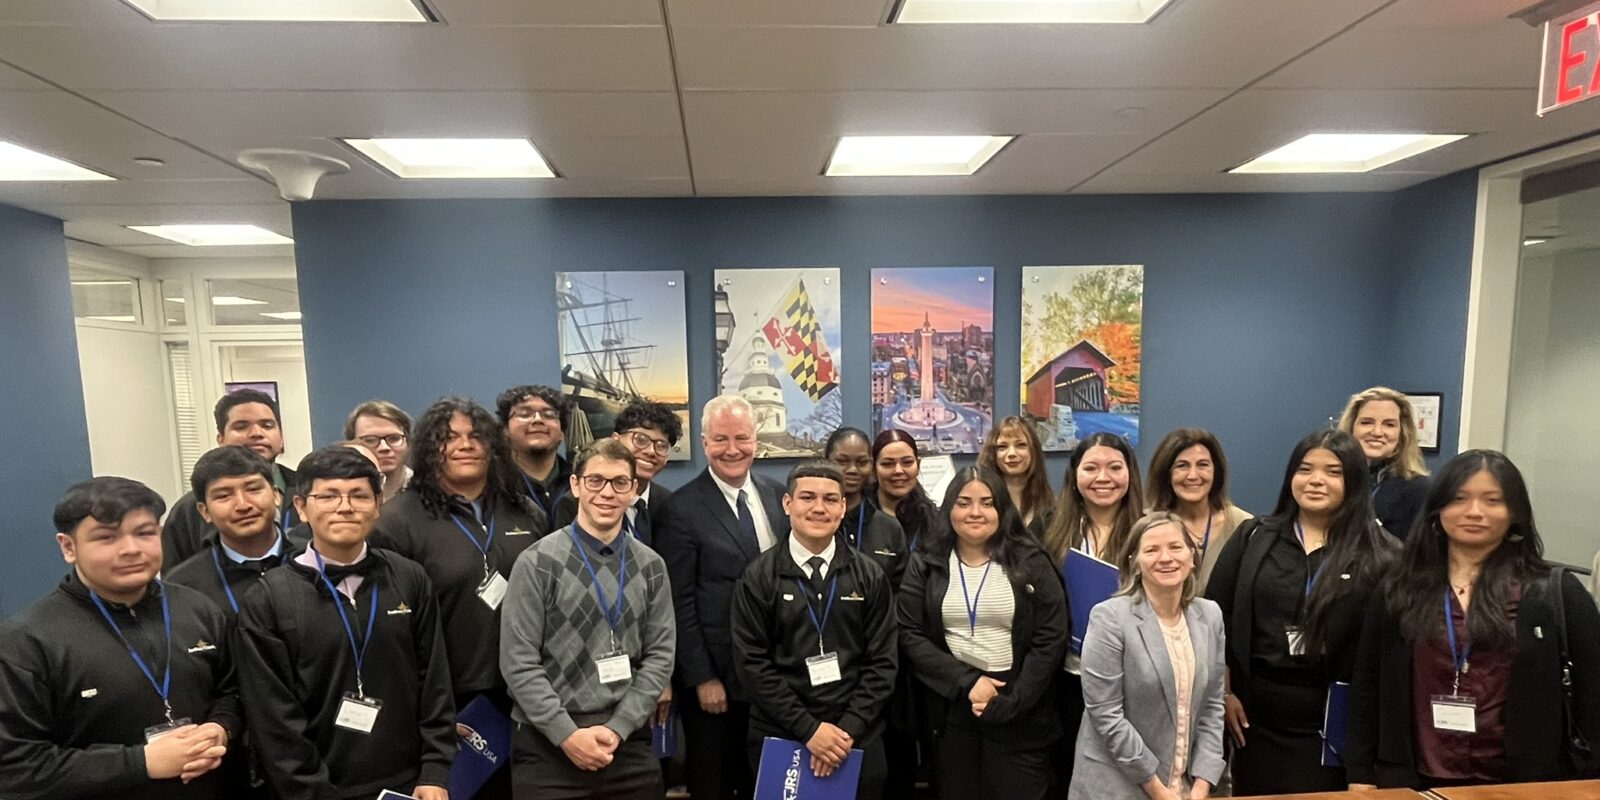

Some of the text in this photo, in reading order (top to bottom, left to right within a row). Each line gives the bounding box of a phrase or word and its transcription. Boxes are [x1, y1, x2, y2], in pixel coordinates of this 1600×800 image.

[483, 747, 498, 764] USA
[784, 768, 798, 794] JRS
[792, 748, 801, 767] USA
